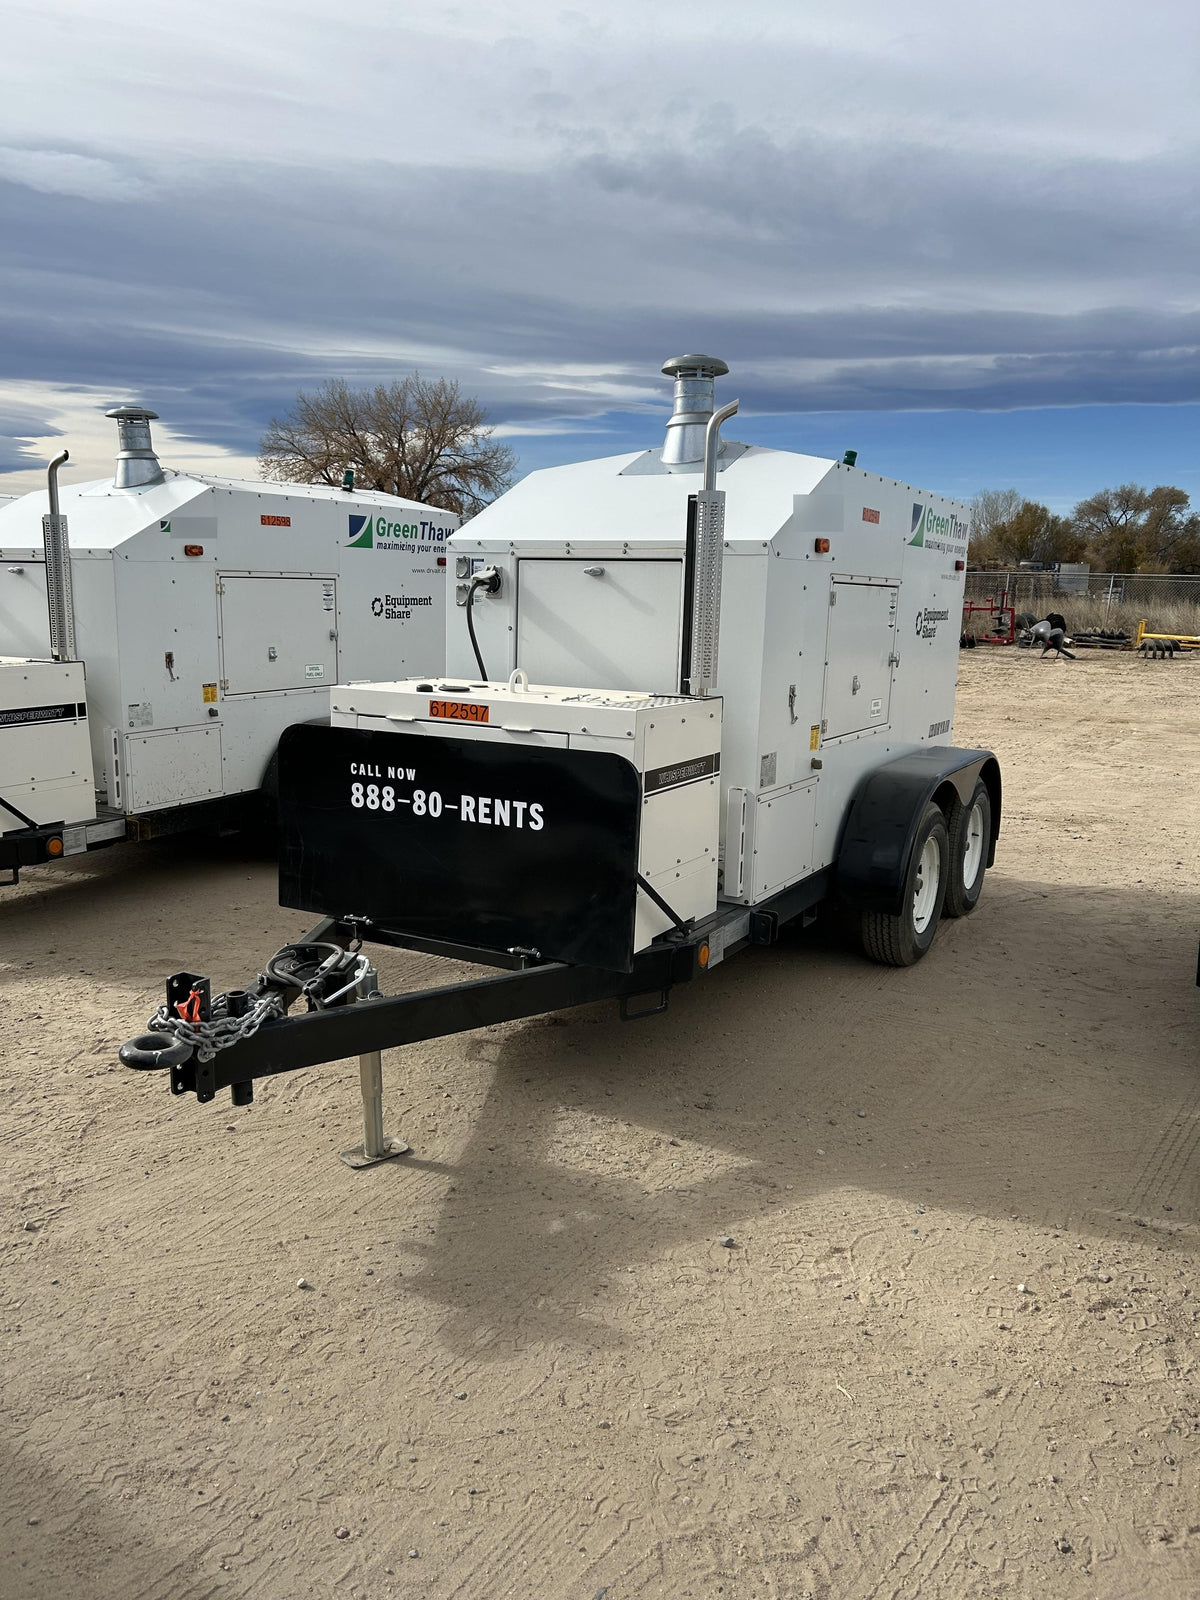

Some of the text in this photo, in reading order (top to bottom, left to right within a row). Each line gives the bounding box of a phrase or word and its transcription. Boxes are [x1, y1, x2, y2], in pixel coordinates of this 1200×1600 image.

[261, 515, 291, 527] 612598
[926, 507, 969, 541] GreenThaw
[376, 541, 416, 554] maximizing
[416, 544, 432, 554] your
[924, 539, 946, 554] maximizing
[385, 594, 432, 608] Equipment
[385, 608, 411, 620] Share
[923, 608, 949, 624] Equipment
[922, 625, 937, 639] Share
[430, 700, 489, 721] 612597
[350, 762, 416, 781] CALL NOW
[658, 761, 707, 785] WHISPERWATT
[351, 782, 544, 831] 888-80-RENTS
